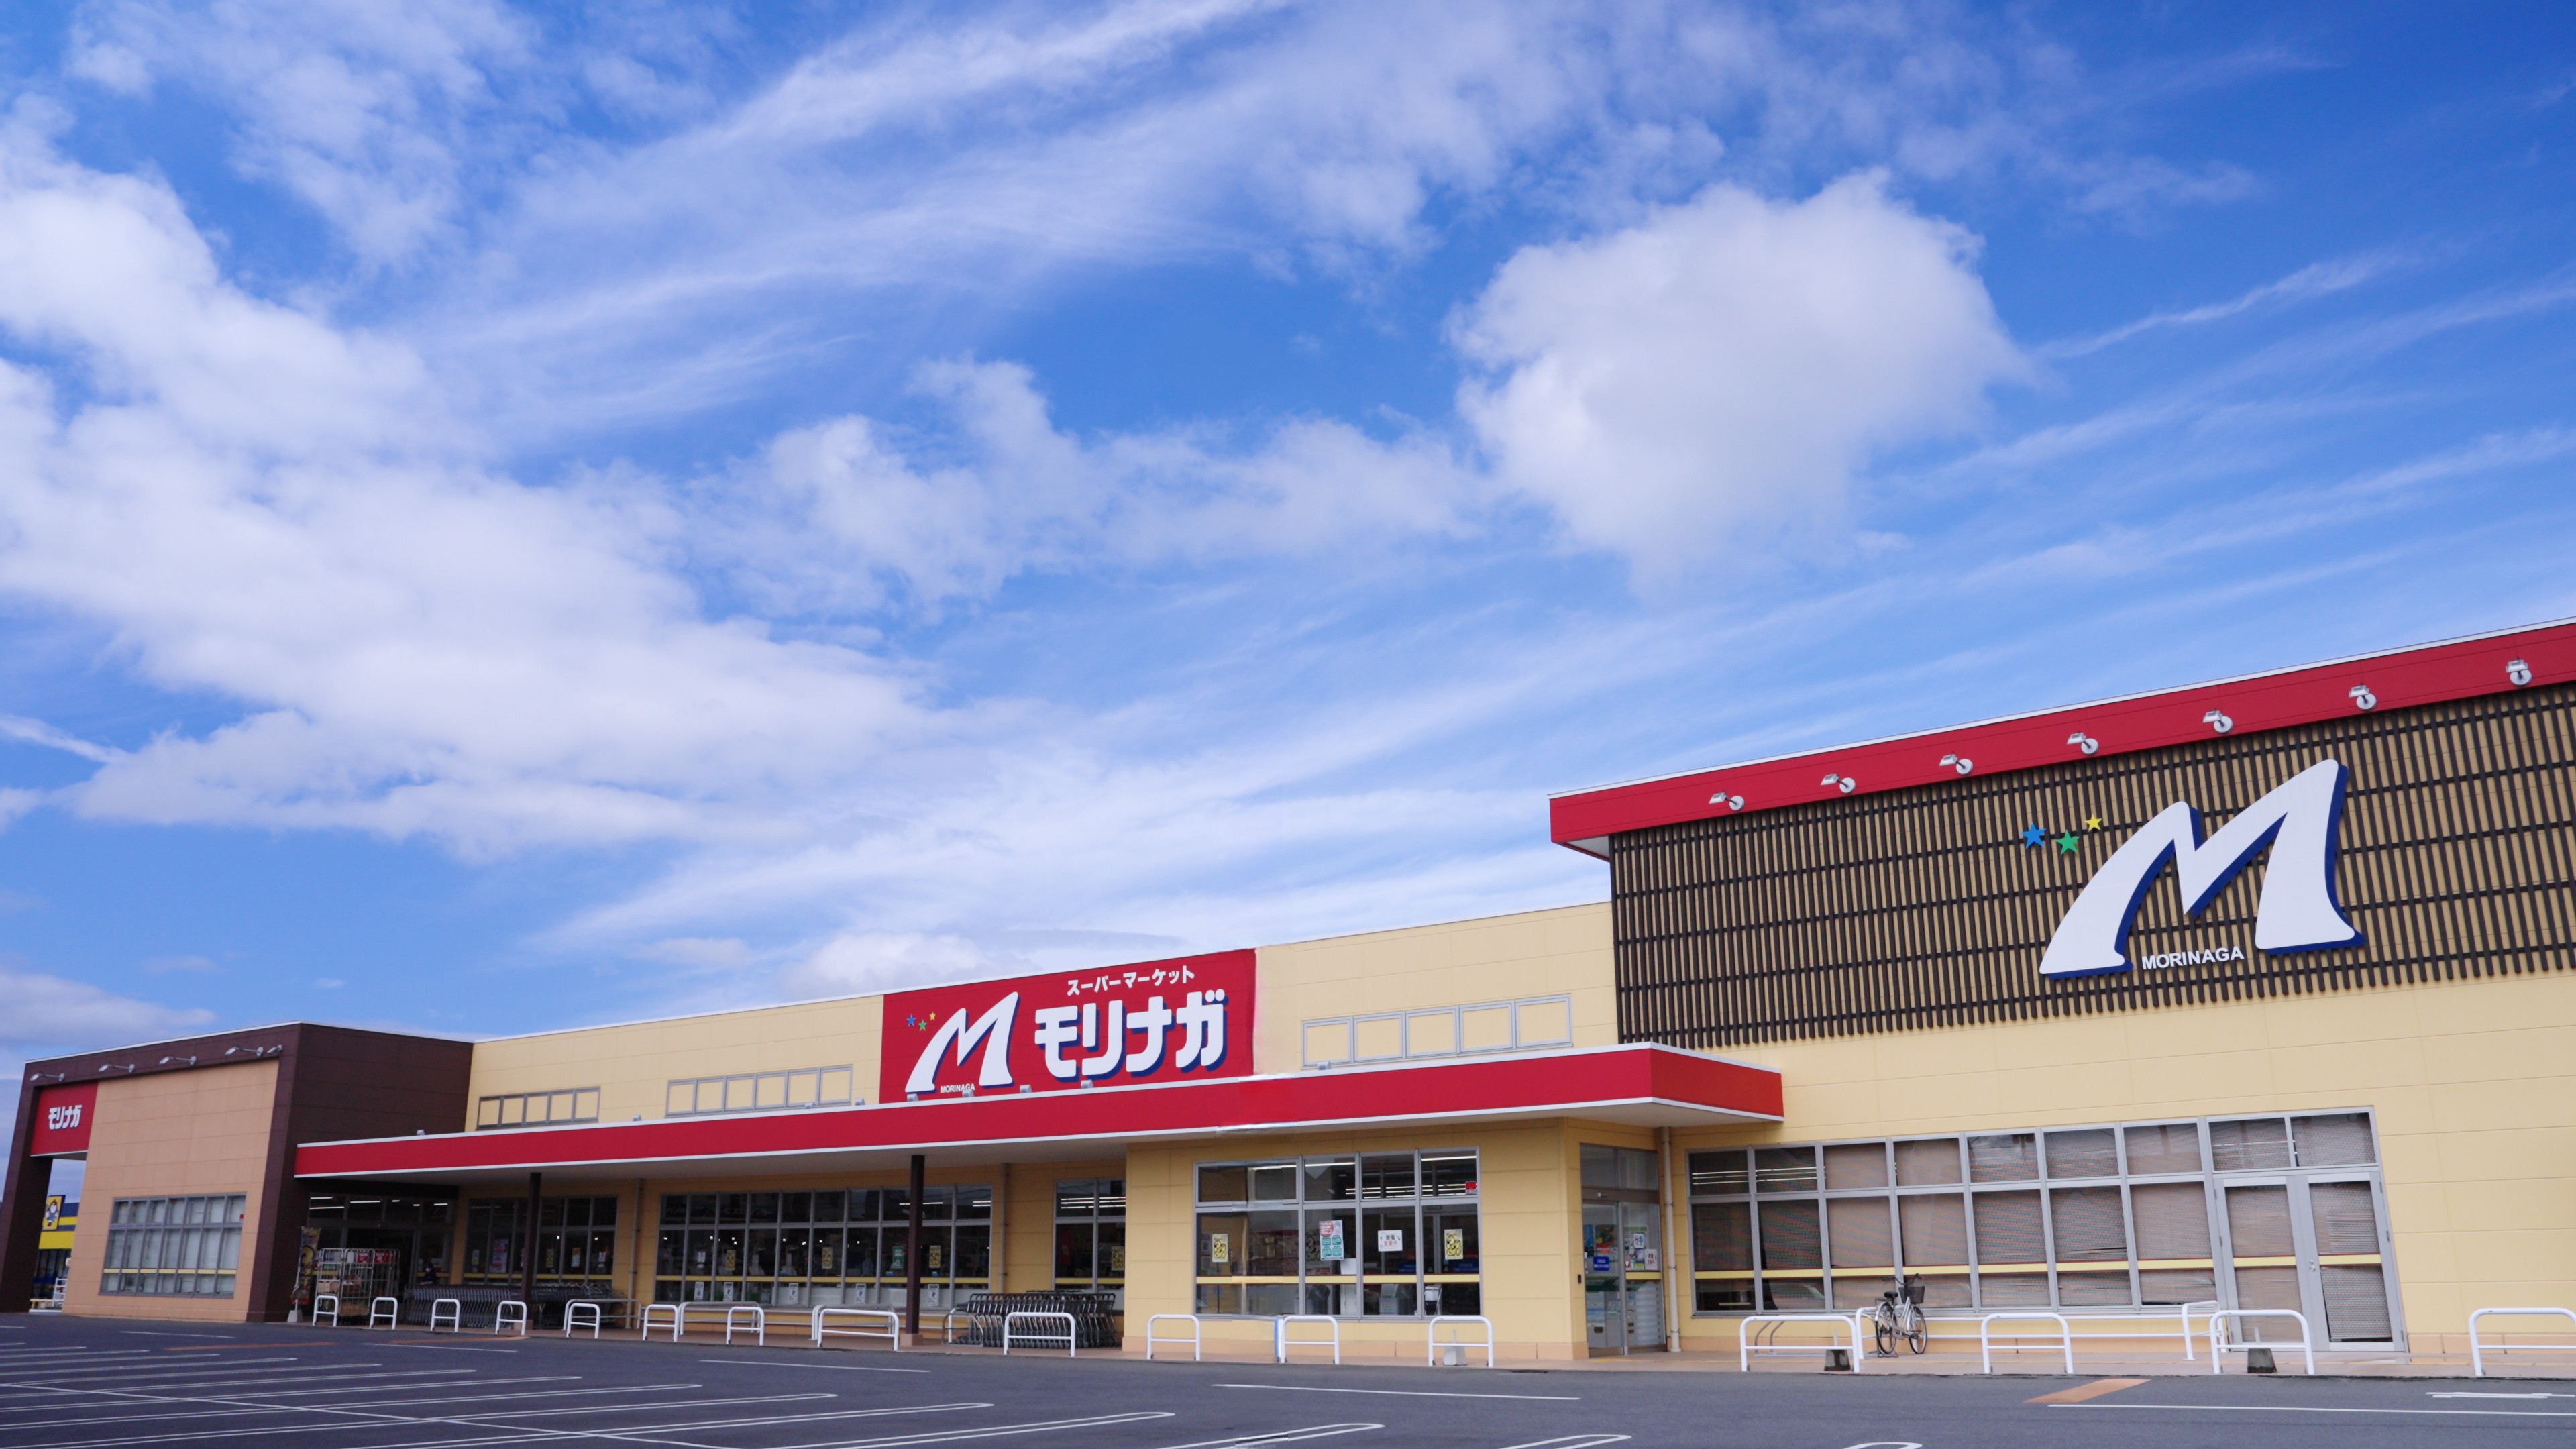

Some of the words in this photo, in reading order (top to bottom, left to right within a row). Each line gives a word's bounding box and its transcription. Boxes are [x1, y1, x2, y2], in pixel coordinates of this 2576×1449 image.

[2039, 759, 2360, 977] M
[2142, 946, 2245, 970] MORINAGA
[1067, 965, 1195, 996] スーパーマーケット
[904, 991, 1020, 1093] M
[1034, 989, 1226, 1079] モリナガ
[940, 1083, 975, 1093] MORINAGA
[48, 1104, 83, 1130] モリナガ
